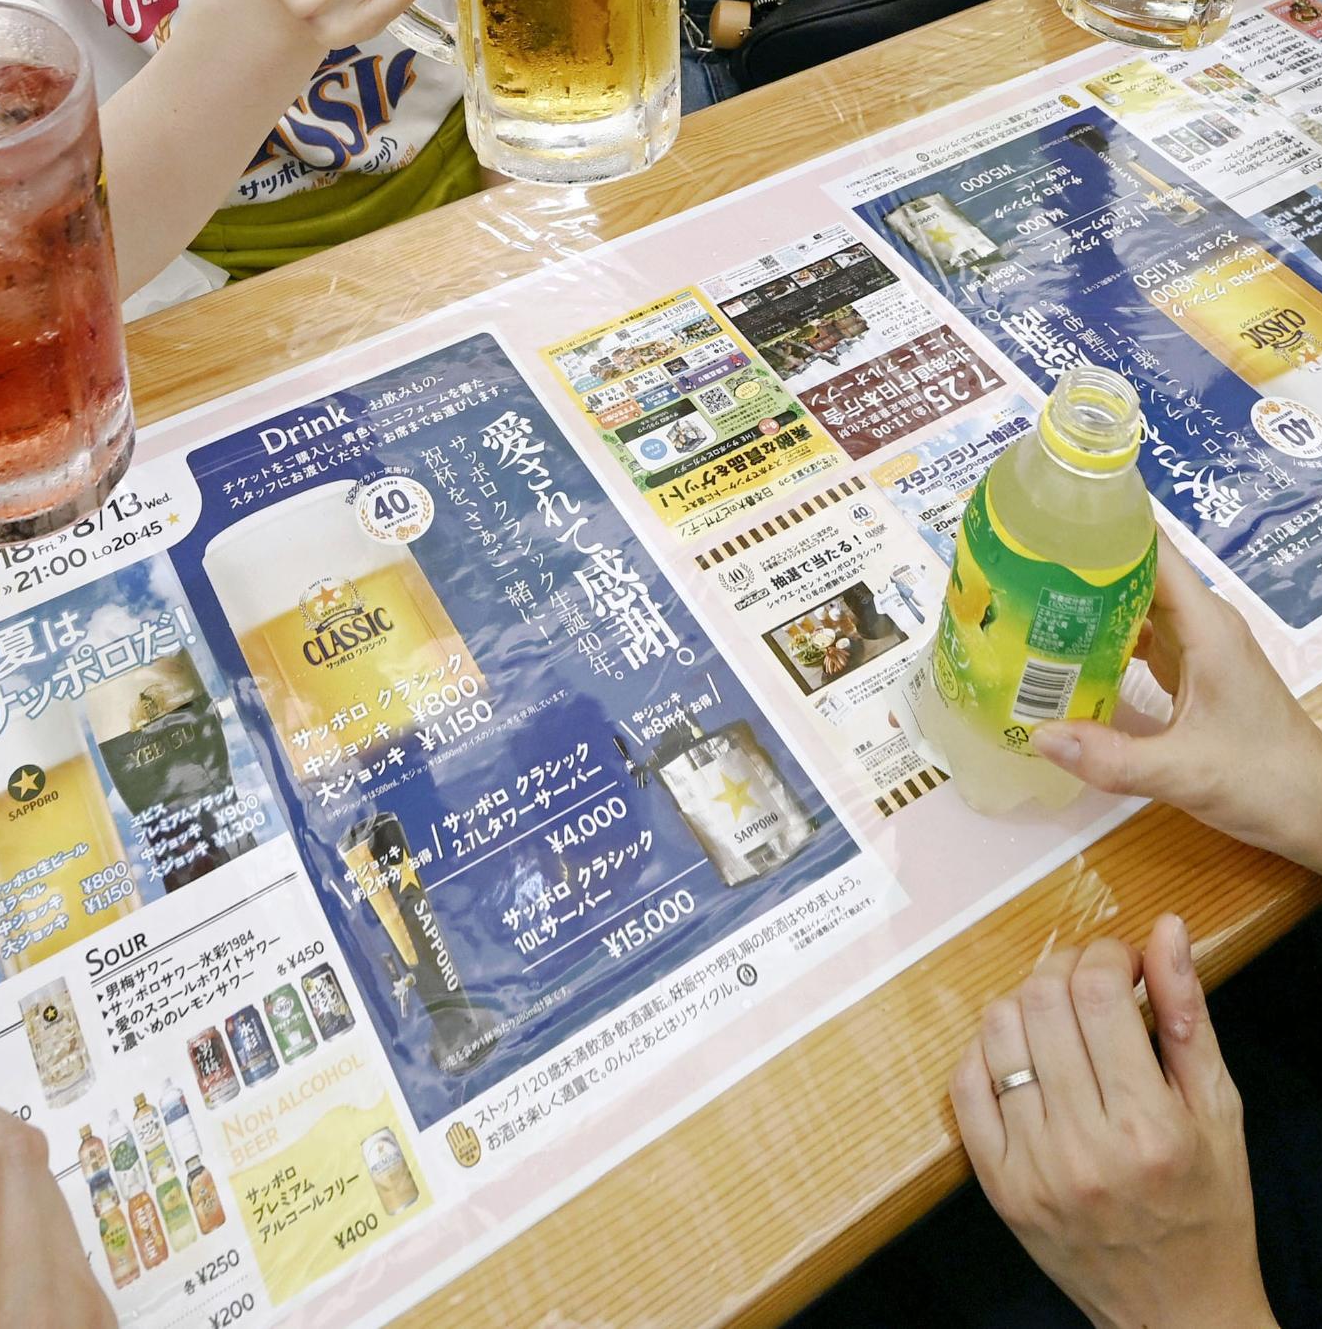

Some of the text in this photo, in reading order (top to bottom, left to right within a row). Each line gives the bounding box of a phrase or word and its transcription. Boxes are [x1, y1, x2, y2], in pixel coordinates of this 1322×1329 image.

[959, 163, 1017, 192] ¥15,000
[1015, 206, 1068, 236] ¥4,000
[1052, 218, 1142, 264] サッポロ クラシック
[1185, 230, 1239, 263] 大ジョッキ
[1133, 257, 1186, 289] ¥1,150
[1150, 272, 1201, 304] ¥800
[1172, 258, 1277, 318] サッポロ クラシック
[1203, 245, 1258, 276] 中ジョッキ
[1239, 308, 1307, 351] CLASSIC
[809, 333, 956, 406] リニューアルオープン
[822, 345, 973, 427] 北海道庁旧本庁舎
[871, 363, 998, 438] 7.25 11:00
[222, 378, 485, 495] チケットをご購入し、黄色いユニフォームを着た
[230, 385, 510, 509] スタッフにお渡しください。お席までお運びします。
[259, 404, 354, 455] Drink
[894, 417, 1033, 495] スタンプラリー抽選会
[657, 423, 814, 508] 素敵な賞品をゲット！
[37, 542, 58, 556] Fri.
[72, 492, 143, 539] 8/13
[144, 492, 173, 511] Wed.
[478, 410, 696, 671] 愛されて感謝。
[678, 485, 774, 538] 日本最大のビアガーデン
[13, 549, 88, 593] 21:00
[111, 520, 163, 551] 20:45
[769, 534, 863, 592] 抽選で当たる！
[303, 605, 394, 667] CLASSIC
[291, 653, 463, 751] サッポロ クラシック
[303, 674, 479, 777] 中ジョッキ ¥800
[632, 692, 682, 724] 中ジョッキ
[315, 699, 493, 807] 大ジョッキ ¥1,150
[8, 790, 60, 822] SAPPORO
[134, 785, 235, 845] プレミアムブラック
[442, 742, 590, 834] サッポロ クラシック
[451, 765, 603, 857] 2.7Lタワーサーバー
[140, 794, 259, 862] 中ジョッキ ¥900
[146, 811, 267, 882] 大ジョッキ ¥1,300
[544, 796, 628, 855] ¥4,000
[733, 811, 779, 844] SAPPORO
[80, 860, 129, 898] ¥800
[343, 845, 401, 884] 中ジョッキ
[501, 830, 654, 931] サッポロ クラシック
[1, 878, 135, 959] 大ジョッキ ¥1,150
[414, 898, 459, 992] SAPPORO
[514, 889, 612, 954] 10Lサーバー
[601, 889, 696, 959] ¥15,000
[85, 932, 148, 977] SOUR
[105, 957, 174, 1001] 男梅サワー
[110, 929, 256, 1016] サッポロサワー氷彩1984
[114, 935, 282, 1036] 愛のスコールホワイトサワー
[121, 970, 256, 1053] 濃いめのレモンサワー
[221, 1053, 365, 1149] NON ALCOHOL
[229, 1128, 279, 1168] BEER
[245, 1165, 298, 1205] サッポロ
[251, 1178, 316, 1224] プレミアム
[257, 1173, 360, 1245] アルコールフリー
[332, 1212, 379, 1251] ¥400
[182, 1248, 241, 1297] 各¥250
[207, 1291, 256, 1329] ¥200
